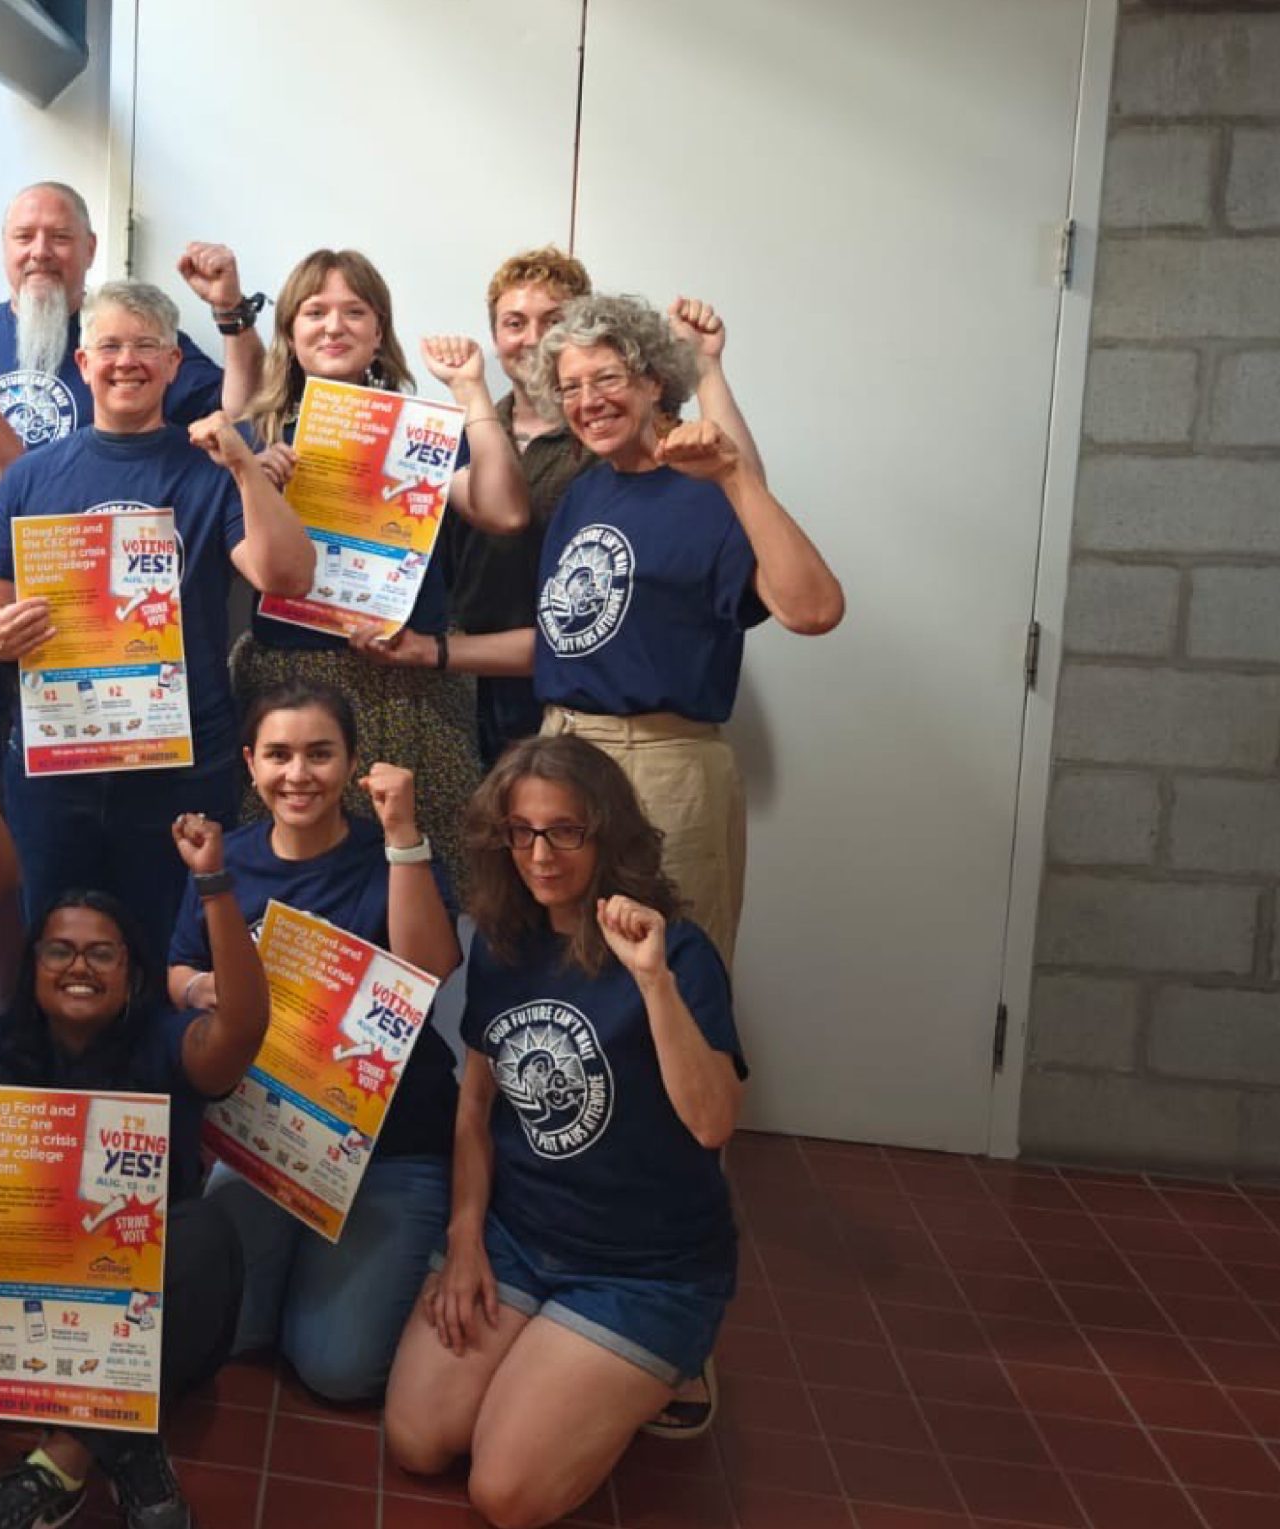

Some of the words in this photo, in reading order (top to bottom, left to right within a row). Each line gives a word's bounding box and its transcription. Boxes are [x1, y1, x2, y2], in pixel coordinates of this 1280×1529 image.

[405, 425, 457, 450] VOTING
[405, 443, 451, 468] YES!
[84, 522, 103, 534] and
[122, 539, 175, 553] VOTING
[128, 554, 172, 573] YES!
[371, 980, 424, 1026] VOTING
[364, 1000, 414, 1045] YES!
[489, 1018, 512, 1045] OUR
[510, 1005, 553, 1027] FUTURE
[555, 1008, 582, 1034] CAN'T
[574, 1028, 597, 1061] WAIT
[14, 1101, 47, 1114] Ford
[50, 1104, 76, 1117] and
[558, 1124, 588, 1150] PLUS
[582, 1074, 606, 1130] ATTENDRE
[0, 1116, 28, 1128] CEC
[31, 1120, 52, 1129] are
[42, 1134, 77, 1146] crisis
[100, 1128, 166, 1155] VOTING
[14, 1147, 64, 1163] college
[103, 1149, 163, 1178] YES!
[115, 1215, 150, 1230] STRIKE
[122, 1229, 147, 1242] VOTE
